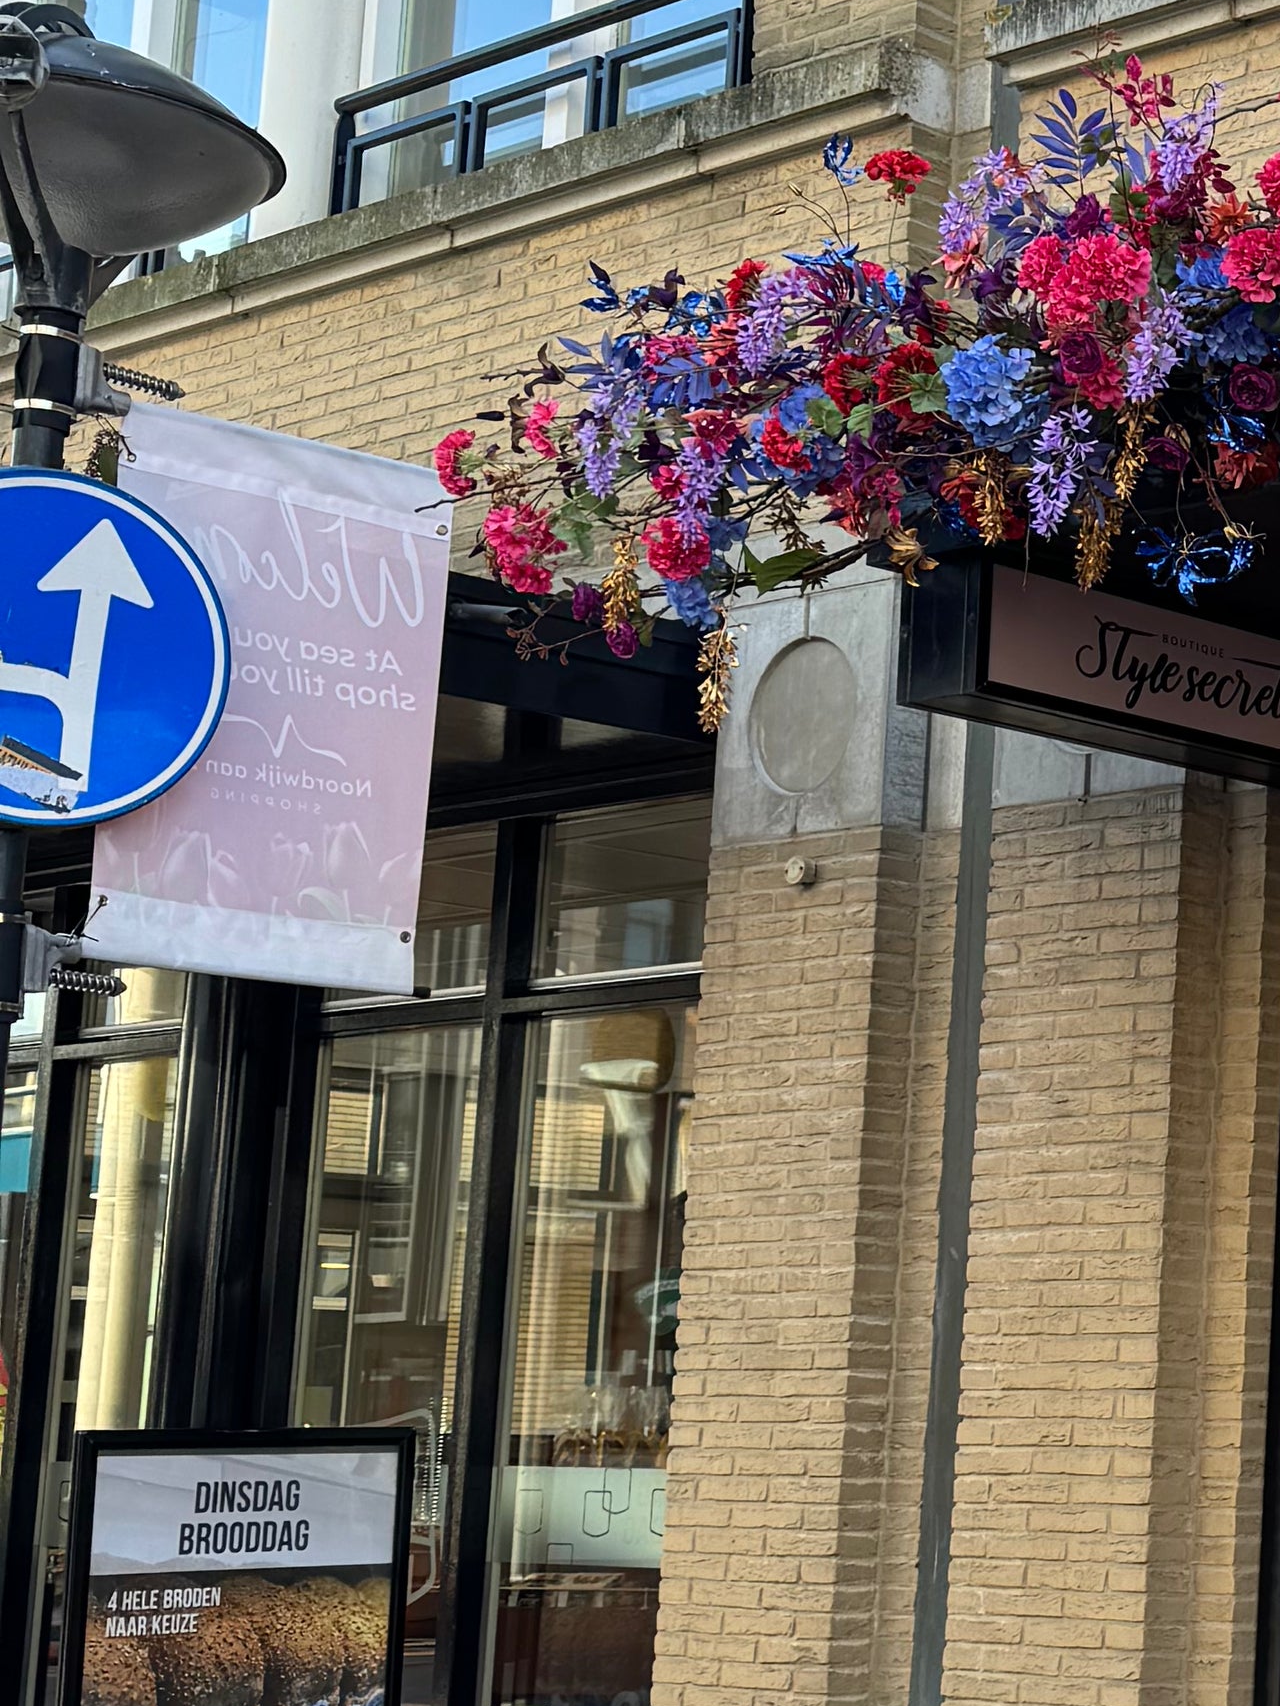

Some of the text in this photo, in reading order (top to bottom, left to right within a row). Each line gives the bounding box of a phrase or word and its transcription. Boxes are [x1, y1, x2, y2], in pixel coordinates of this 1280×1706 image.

[1161, 633, 1226, 659] BOUTIQUE
[194, 1479, 301, 1514] DINSDAG
[178, 1519, 310, 1556] BROODDAG
[107, 1586, 222, 1612] 4 HELE BRODEN
[105, 1612, 200, 1638] NAAR KEUZE
